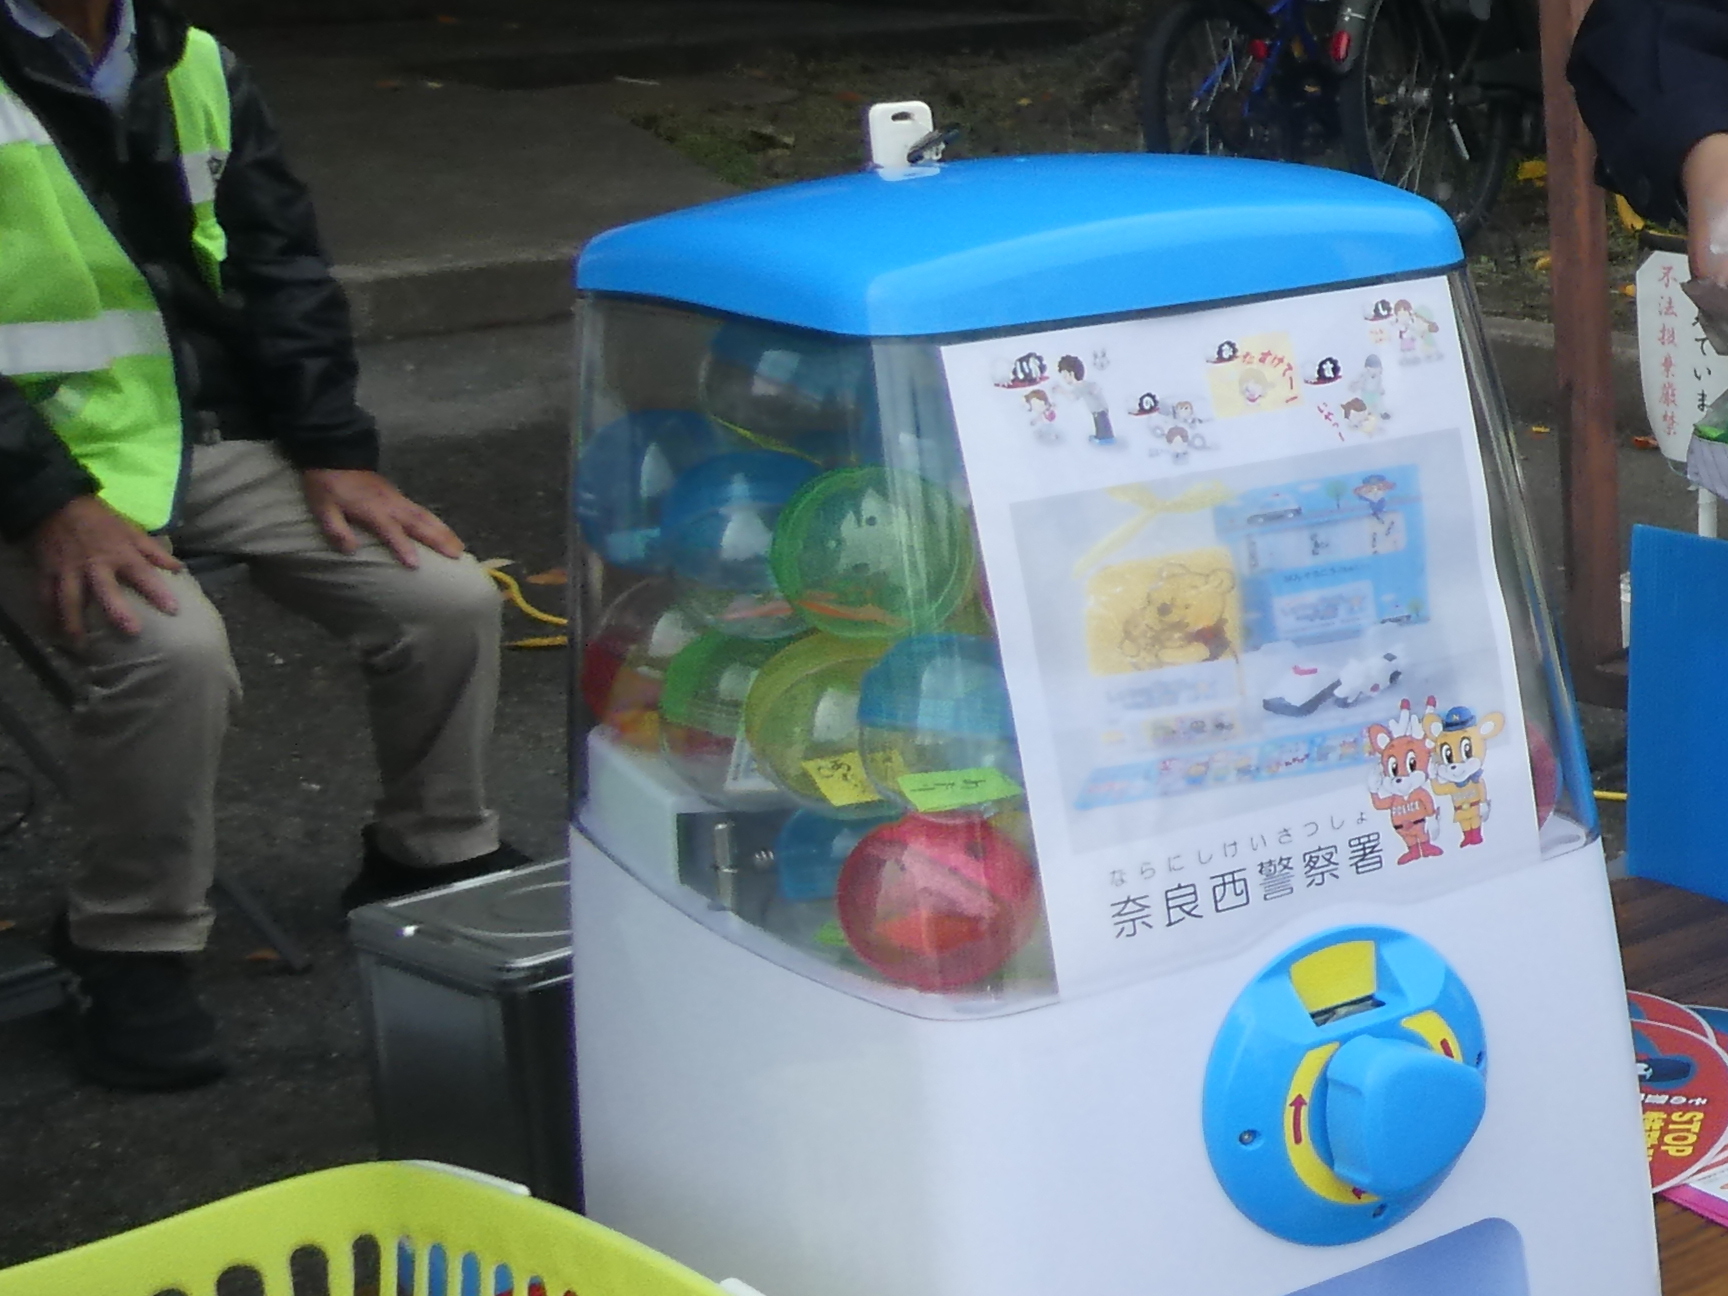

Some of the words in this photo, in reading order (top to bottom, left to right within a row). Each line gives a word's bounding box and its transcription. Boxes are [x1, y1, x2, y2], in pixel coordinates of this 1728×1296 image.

[1657, 265, 1678, 436] 不法投棄厳禁
[1109, 811, 1369, 888] ならにしけいさつしょ
[1110, 831, 1384, 940] 奈良西警察署
[1660, 1110, 1705, 1158] STOP
